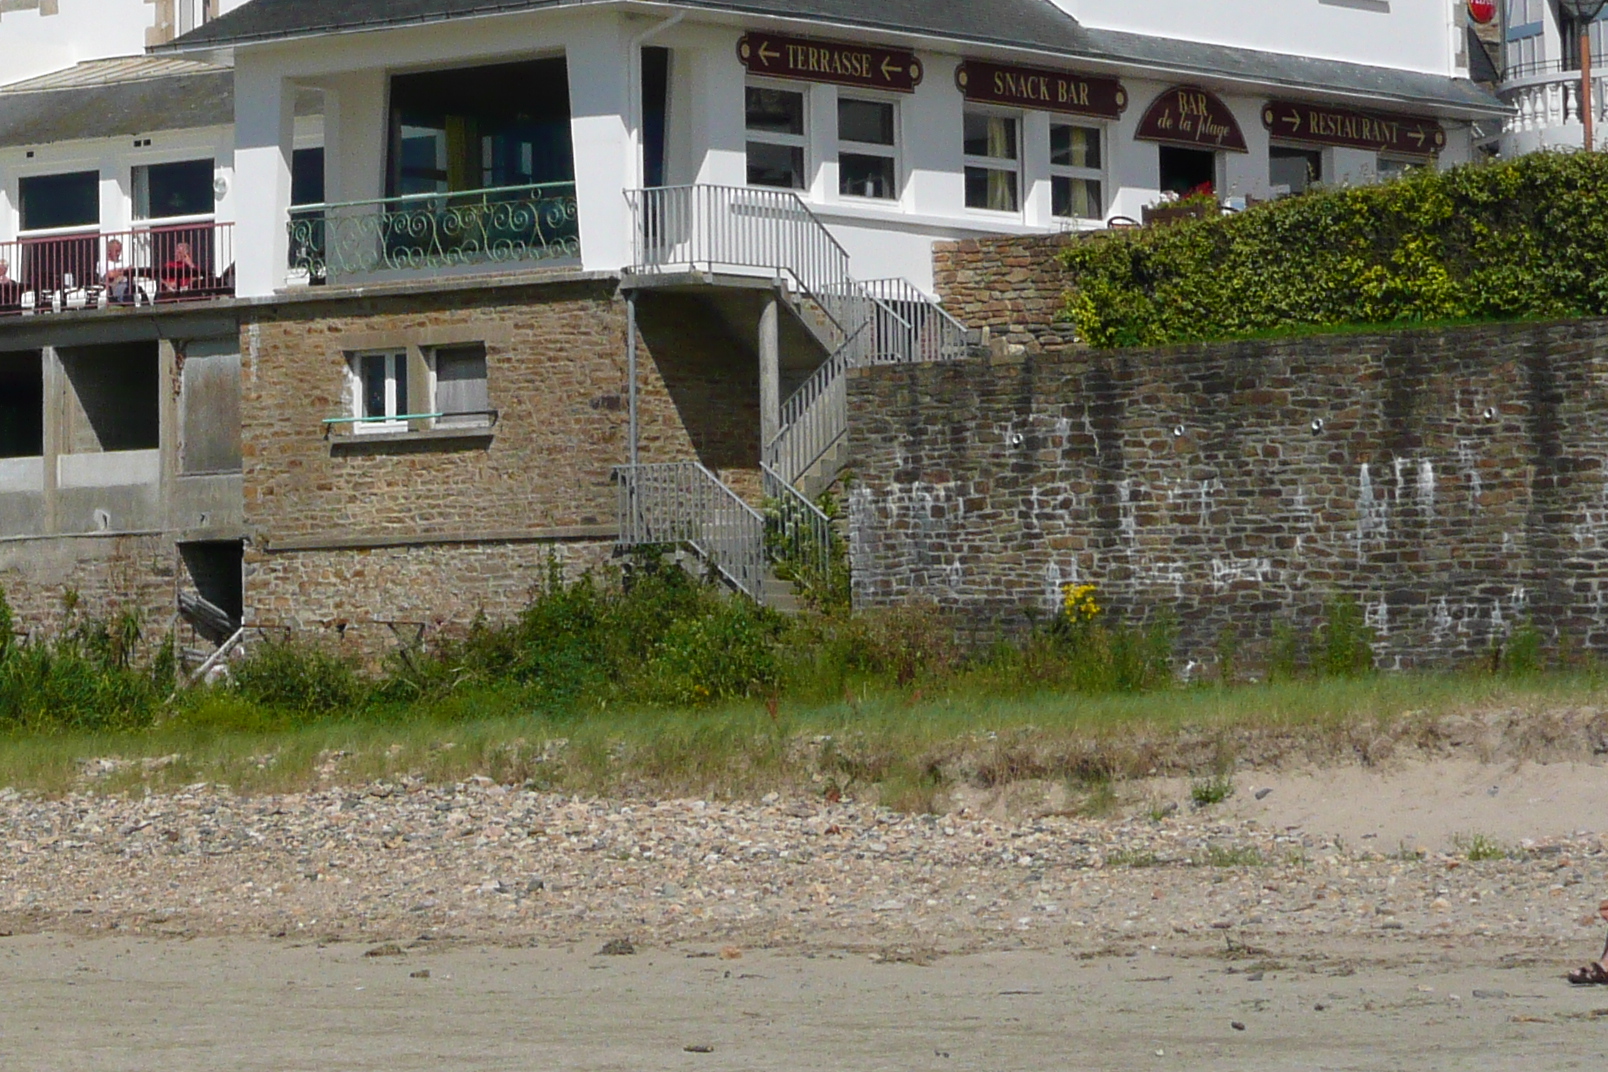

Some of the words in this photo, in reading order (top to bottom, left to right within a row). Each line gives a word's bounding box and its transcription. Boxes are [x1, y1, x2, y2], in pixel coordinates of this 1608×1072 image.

[786, 44, 872, 78] TERRASSE
[994, 71, 1050, 101] SNACK
[1057, 80, 1089, 106] BAR
[1178, 92, 1207, 116] BAR
[1157, 108, 1173, 129] de
[1179, 112, 1192, 132] la
[1195, 115, 1231, 145] plage
[1309, 111, 1398, 144] RESTAURANT
